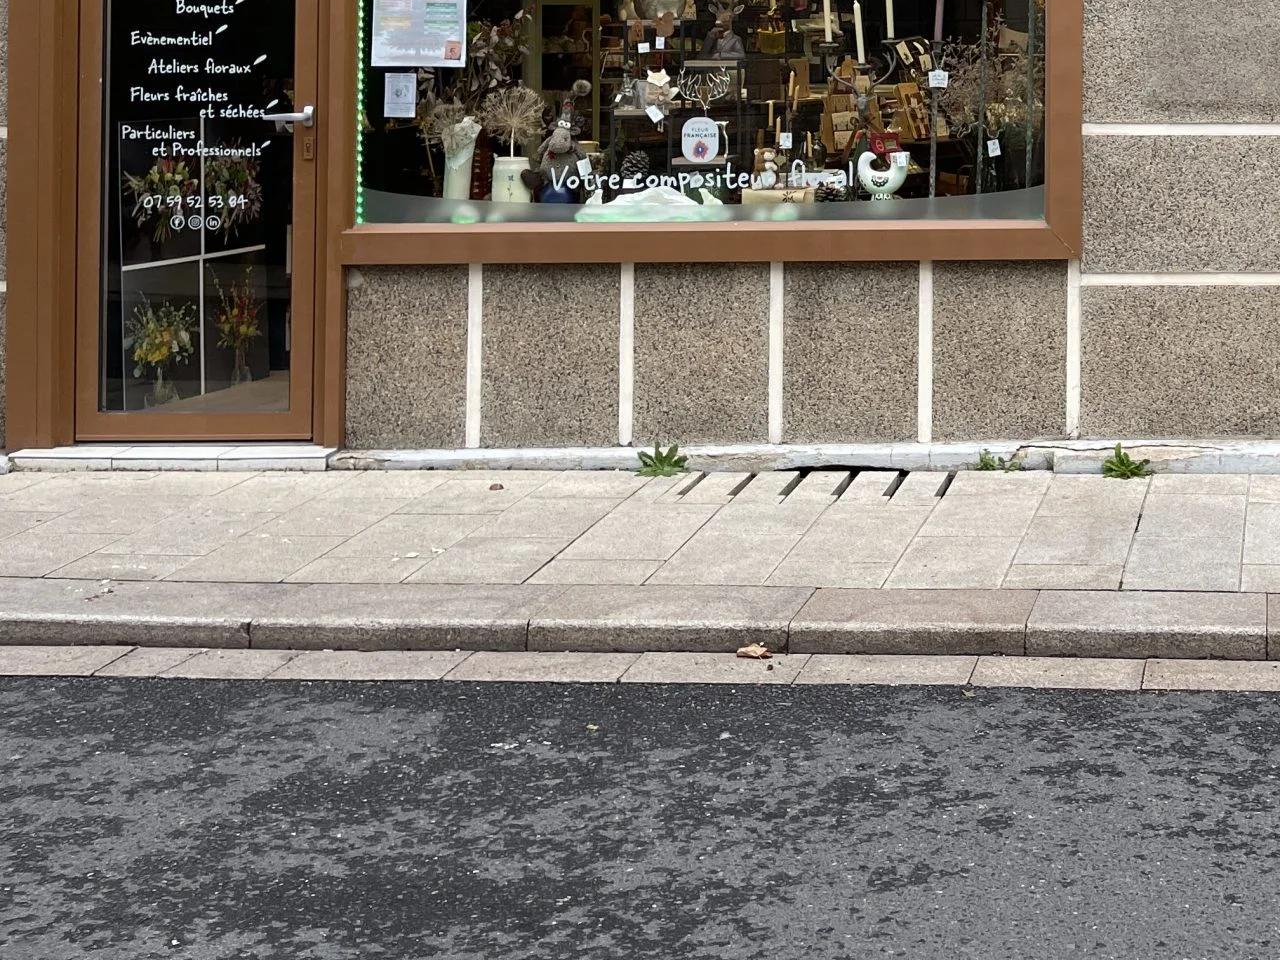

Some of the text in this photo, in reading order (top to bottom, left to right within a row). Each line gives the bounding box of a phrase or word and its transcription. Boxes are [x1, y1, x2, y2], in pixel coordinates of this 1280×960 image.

[131, 30, 212, 46] Evènementiel
[148, 57, 251, 74] Ateliers floraux
[130, 85, 228, 102] Fleurs fraîches
[199, 104, 265, 119] et séchées
[122, 125, 195, 140] Particuliers
[152, 140, 261, 157] et Professionnels
[551, 165, 621, 191] Votre
[143, 195, 248, 209] 07 59 52 53 84
